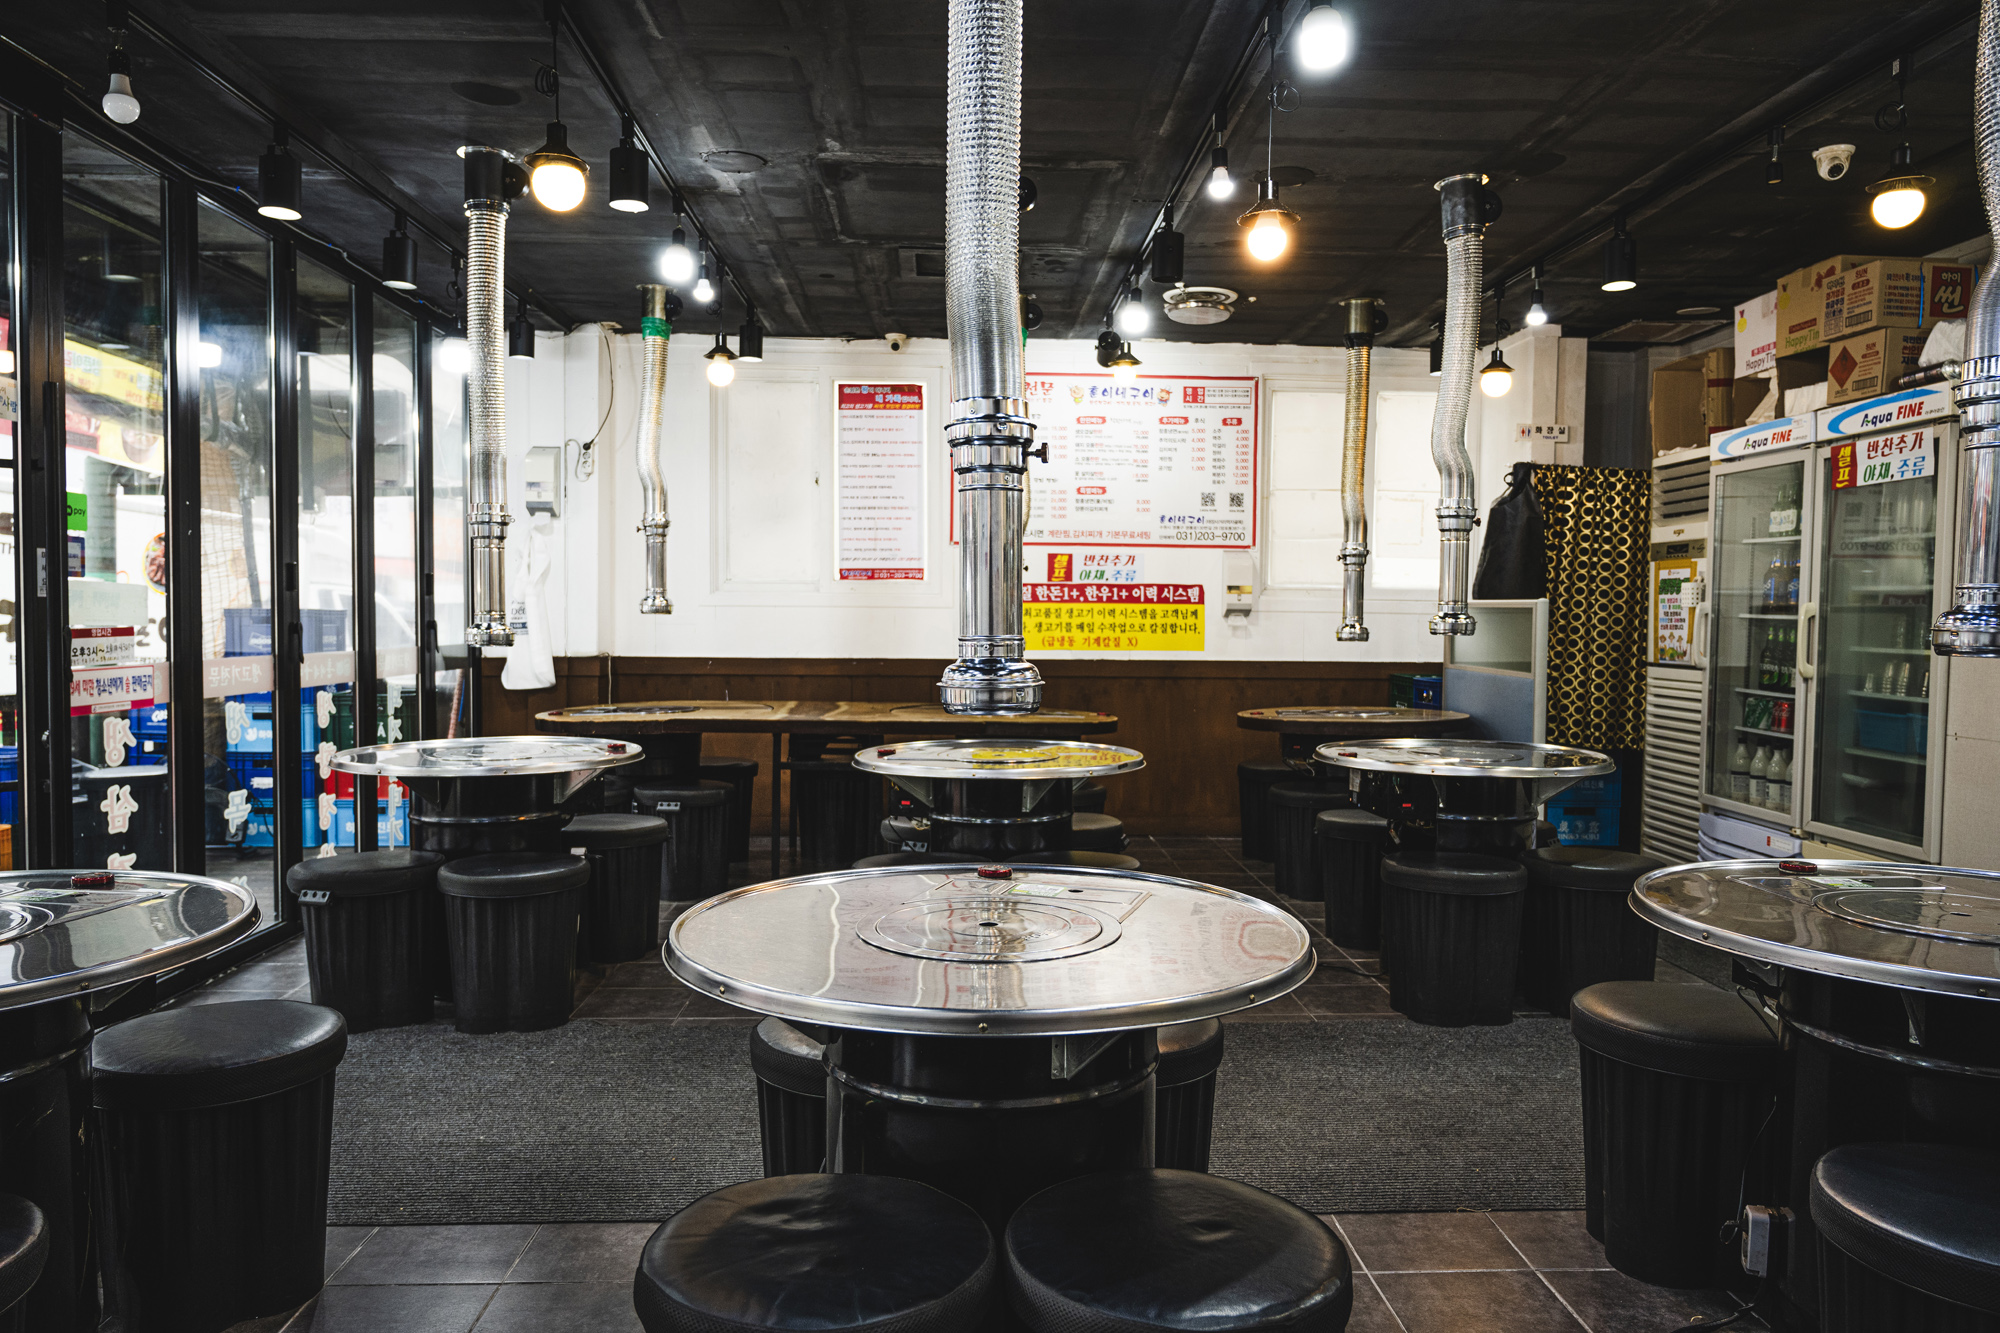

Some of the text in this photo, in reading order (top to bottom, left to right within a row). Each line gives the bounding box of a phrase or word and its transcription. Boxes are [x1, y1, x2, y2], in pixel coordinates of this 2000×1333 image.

[1941, 271, 1961, 283] 하이
[1861, 401, 1924, 428] Aqua FINE
[1535, 426, 1566, 435] 화장실
[1744, 429, 1793, 450] Aqua FINE
[1866, 430, 1924, 460] 반찬추가
[1835, 445, 1852, 488] 셀프
[73, 507, 87, 516] pay
[1175, 531, 1246, 541] 031)203-9700
[1083, 554, 1136, 567] 반찬추가
[1132, 586, 1158, 603] 이력
[1161, 586, 1200, 603] 시스템
[1064, 607, 1094, 619] 생고기
[1097, 607, 1116, 619] 이력
[1120, 608, 1158, 620] 시스템을
[1160, 608, 1199, 620] 고객님께
[91, 628, 112, 637] 영업시간
[1034, 621, 1074, 634] 생고기를
[1075, 621, 1095, 633] 매일
[1097, 622, 1147, 634] 수작업으로
[1126, 636, 1139, 648] X)
[82, 678, 94, 697] 미만
[95, 675, 124, 697] 청소년에게
[125, 675, 131, 694] 술
[131, 674, 153, 693] 판매금지
